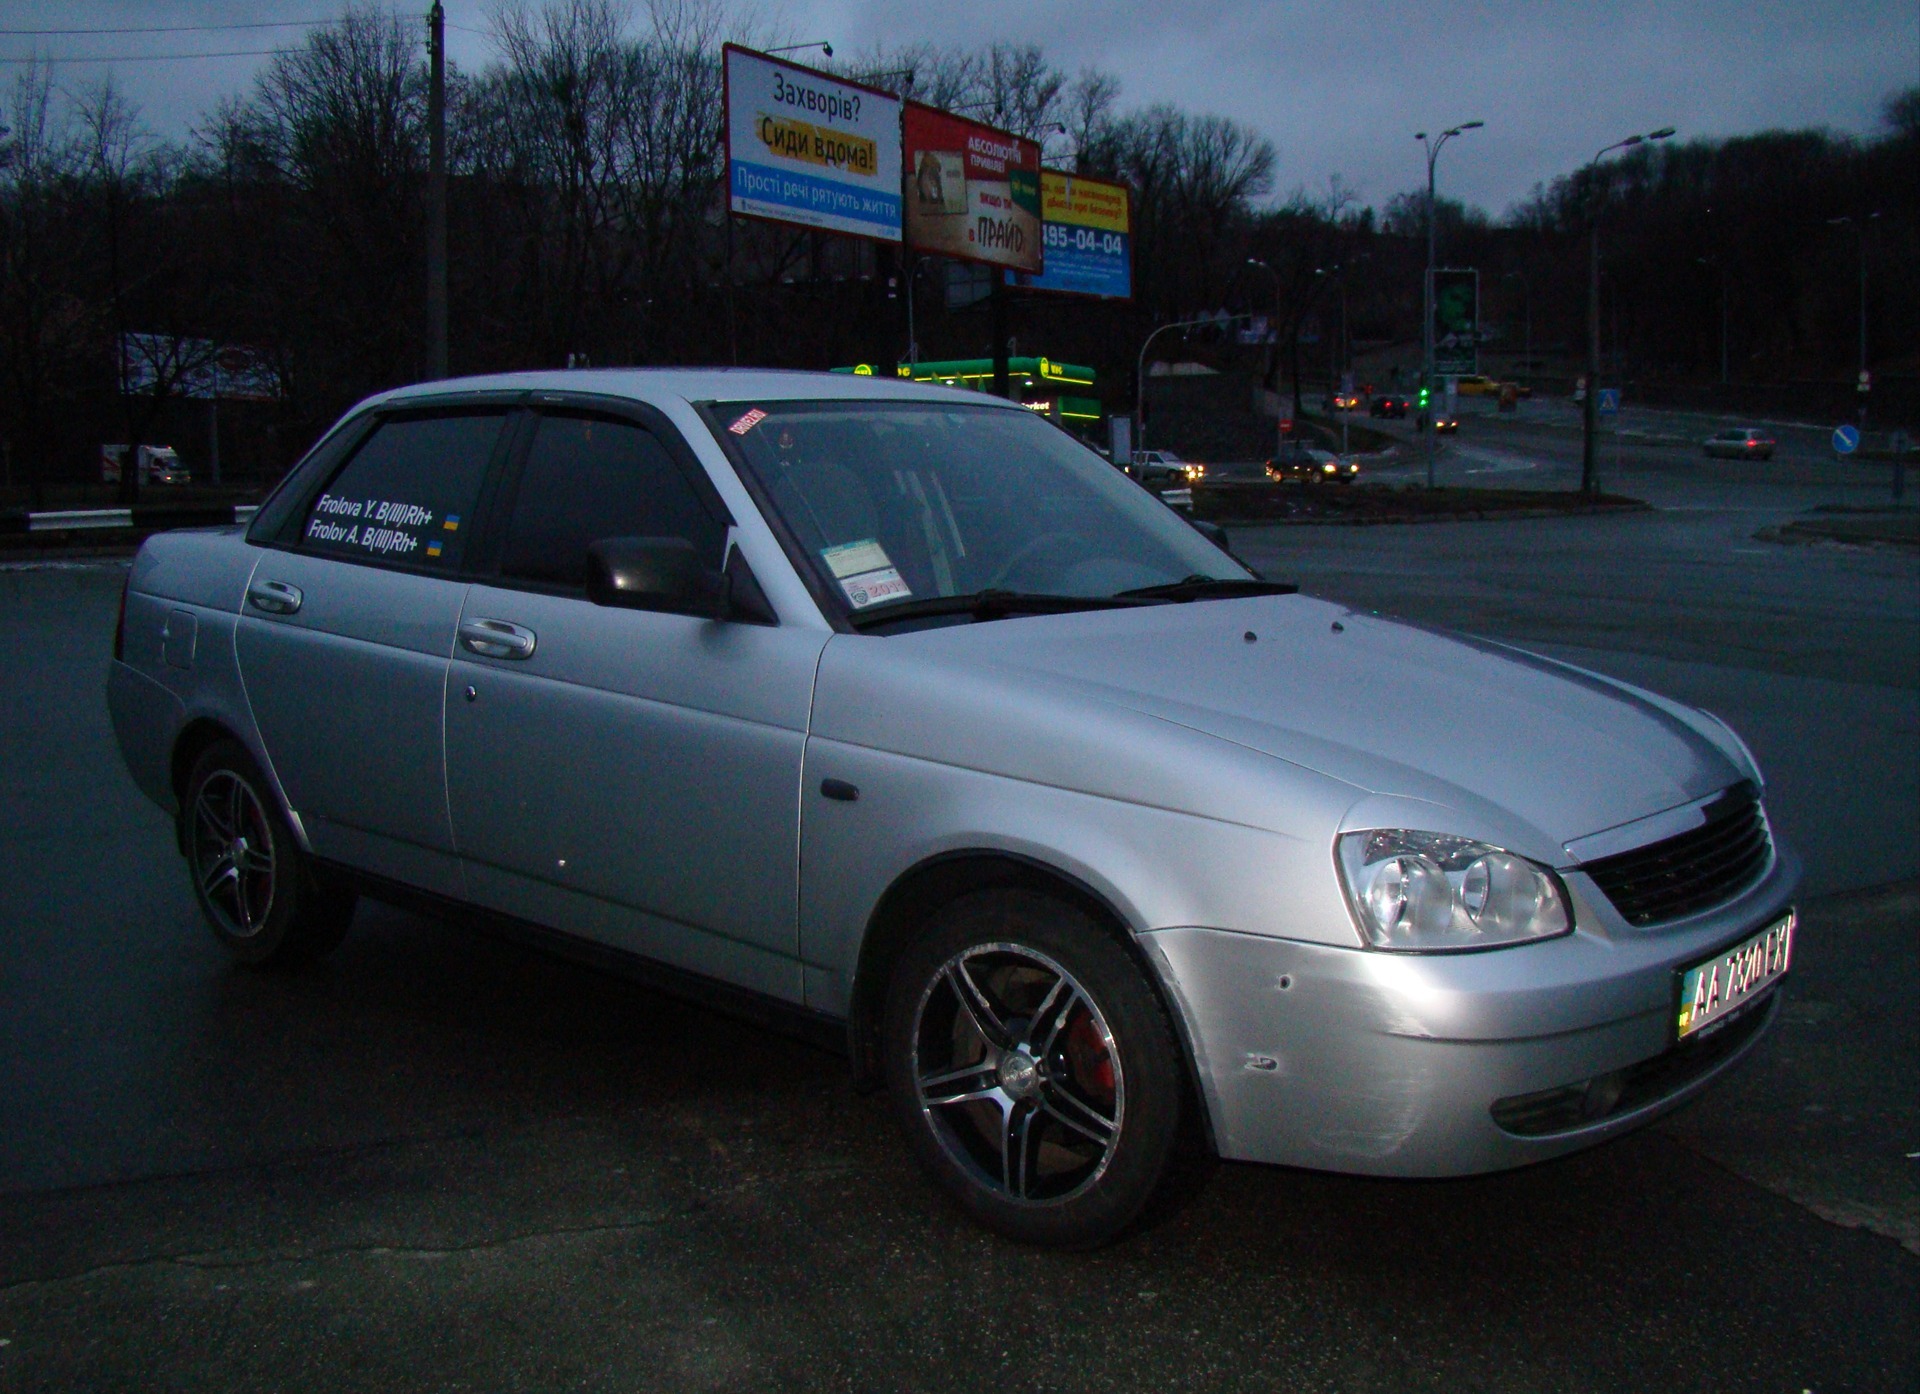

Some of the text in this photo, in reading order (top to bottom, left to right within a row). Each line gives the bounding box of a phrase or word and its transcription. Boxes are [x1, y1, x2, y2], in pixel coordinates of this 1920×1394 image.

[773, 71, 861, 123] Захворів?
[762, 116, 874, 170] Сиди вдома!
[737, 166, 897, 218] Прості речі рятують життя
[307, 519, 348, 542] Frolov
[346, 524, 360, 544] A.
[316, 494, 363, 518] Frolova
[364, 499, 378, 519] Y.
[1691, 964, 1719, 1022] AA
